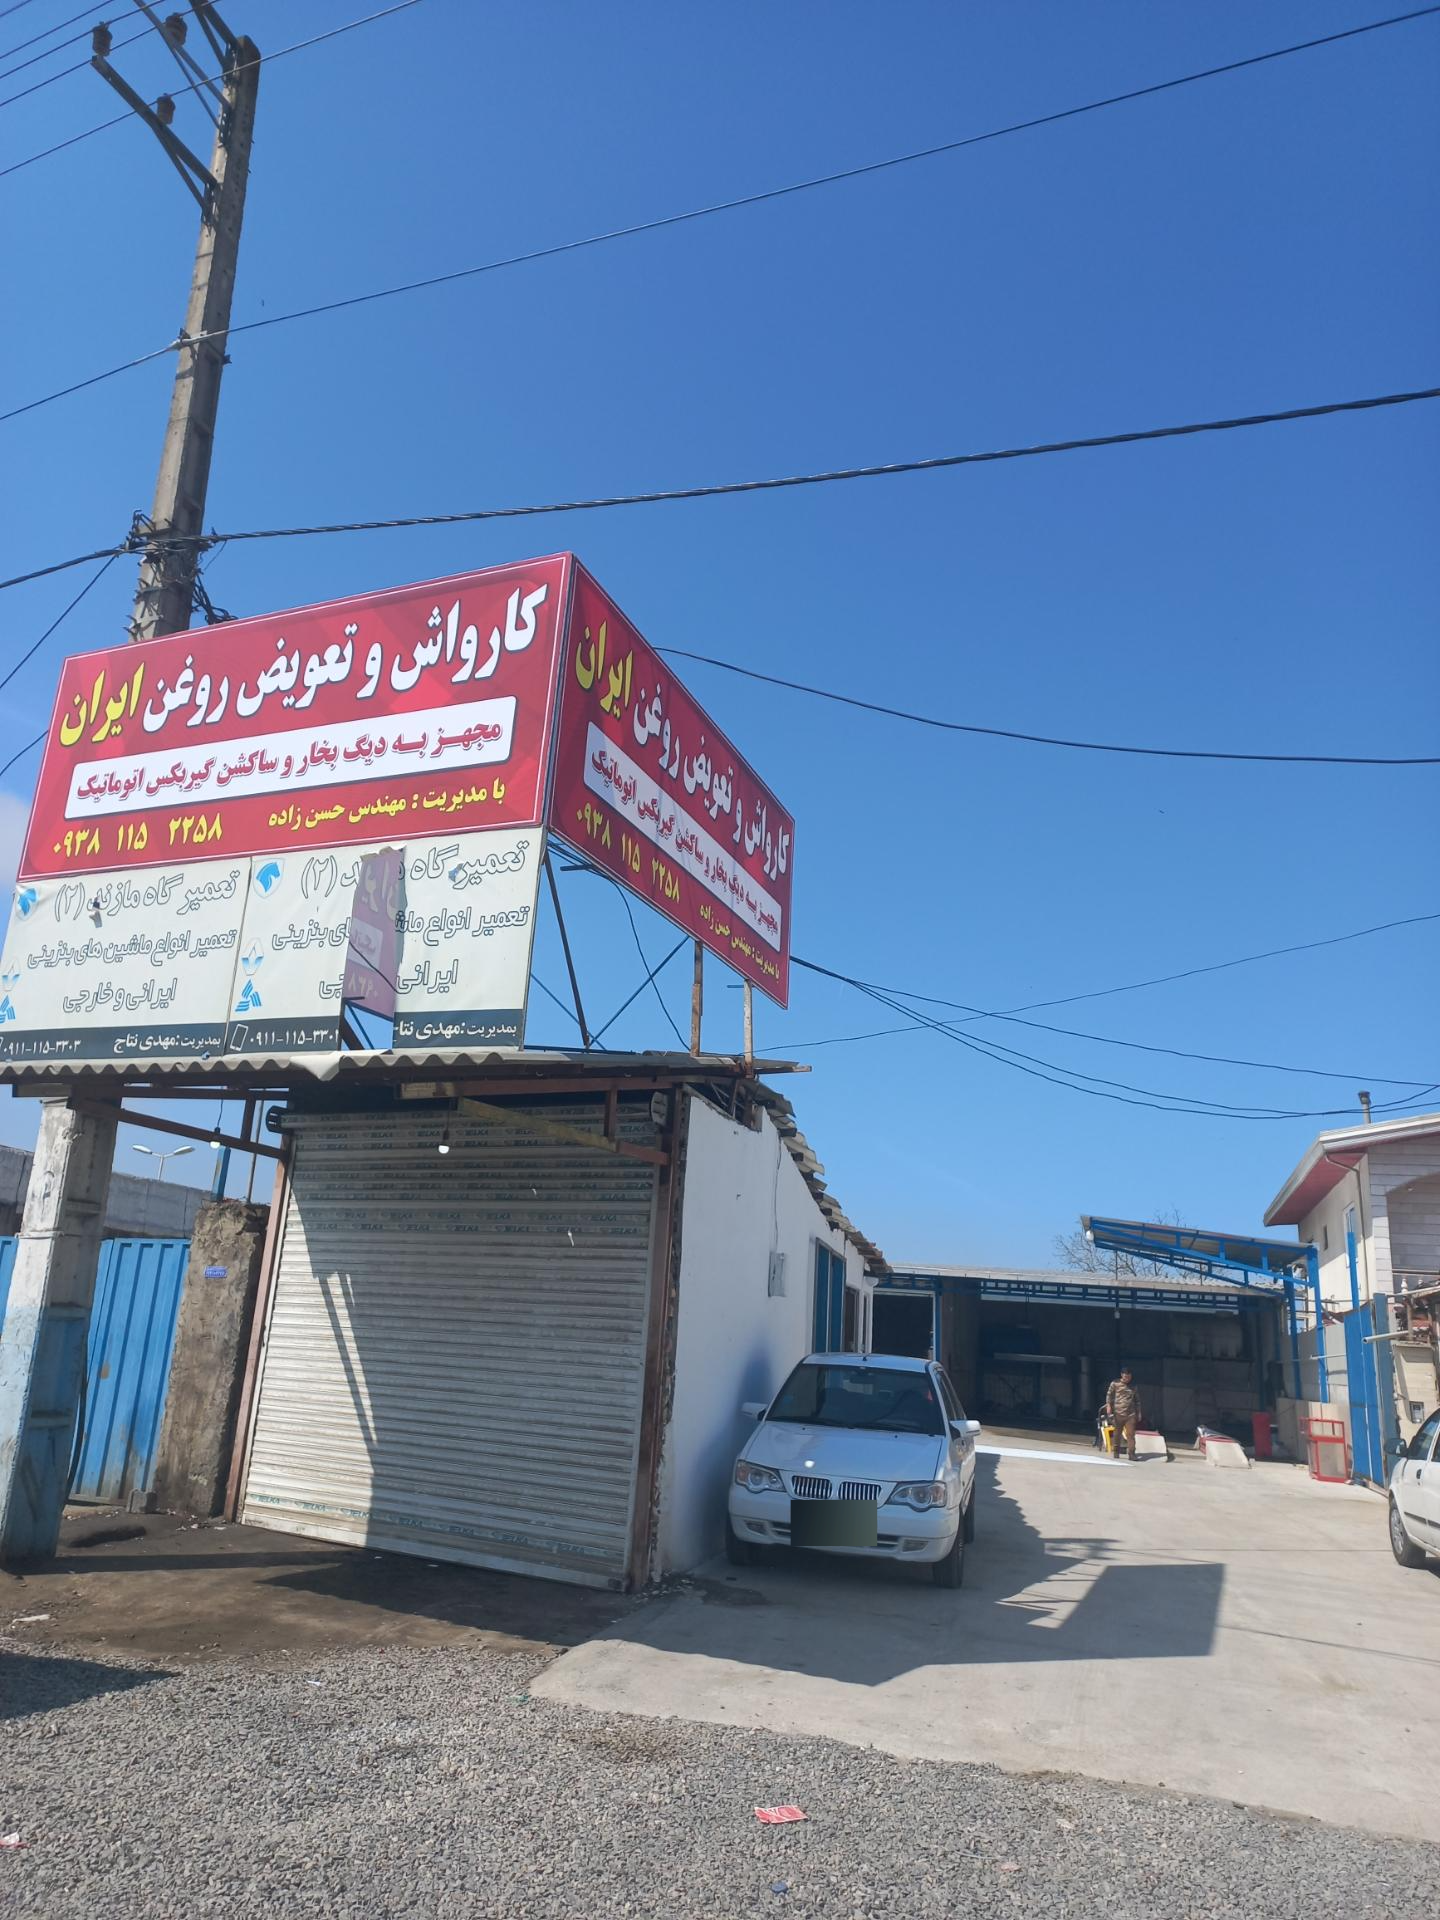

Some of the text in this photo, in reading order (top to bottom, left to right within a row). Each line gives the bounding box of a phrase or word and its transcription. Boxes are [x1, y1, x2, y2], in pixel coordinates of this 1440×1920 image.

[59, 583, 548, 746] کارواش و تعویض روغن ایران
[295, 740, 338, 776] بخار
[342, 735, 387, 765] دیگ
[392, 730, 428, 758] به
[575, 620, 790, 881] کارواش و تعویض روغن ایران
[146, 755, 216, 793] گیربکس
[216, 748, 278, 785] ساکشن
[280, 753, 294, 777] و
[77, 766, 145, 802] اتوماتیک
[422, 785, 488, 814] مدیریت
[492, 776, 506, 801] با
[268, 804, 302, 831] زاده
[304, 804, 345, 828] حسن
[348, 797, 406, 824] مهندس
[53, 812, 223, 858] ۰۹۳۸ ۱۱۵ ۲۲۵۸
[577, 802, 680, 904] ۰۹۳۸ ۱۱۵ ۲۲۵۸
[271, 920, 328, 950] بنزینی
[423, 906, 472, 946] انواع
[472, 906, 530, 937] تعمیر
[27, 929, 238, 969] تعمیر انواع ماشین های بنزینی
[397, 959, 459, 995] ایرانی
[63, 977, 178, 1013] ایرانی و خارجی
[113, 1033, 138, 1054] نتاج
[393, 1020, 414, 1041] نتا
